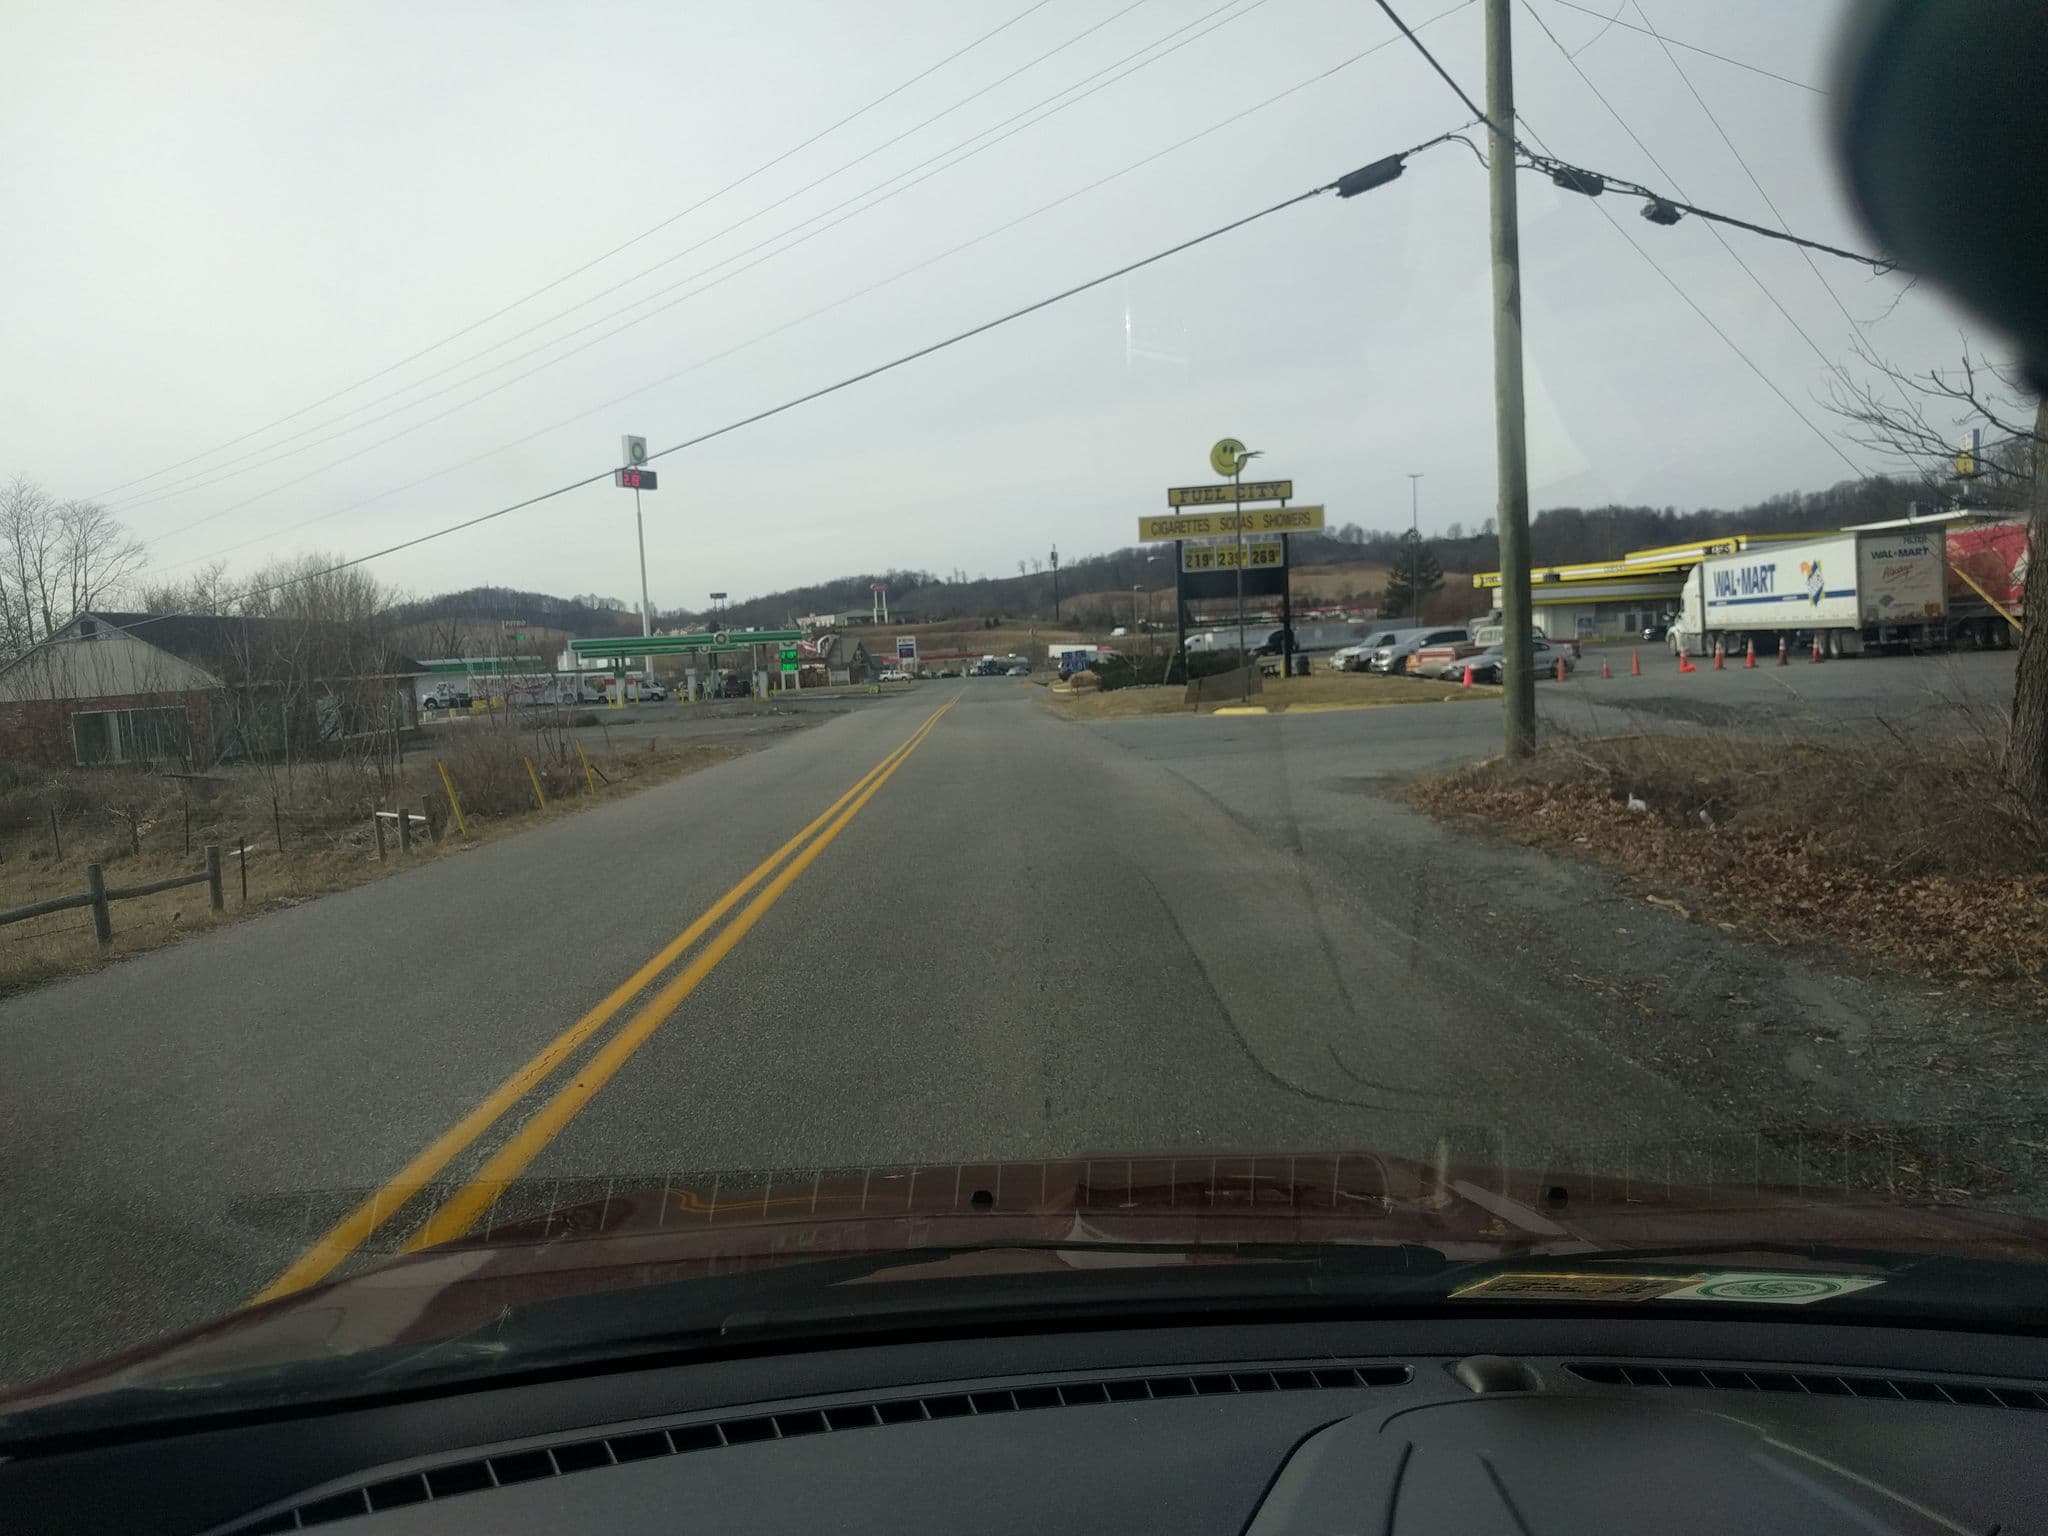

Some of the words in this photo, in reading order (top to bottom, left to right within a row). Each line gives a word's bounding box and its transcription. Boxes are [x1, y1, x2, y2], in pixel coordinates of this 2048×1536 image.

[1179, 487, 1226, 503] FUEL
[1236, 485, 1281, 499] CITY
[1151, 518, 1210, 537] CIGARETTES
[1220, 515, 1254, 531] SODAS
[1262, 512, 1312, 529] SHOWERS
